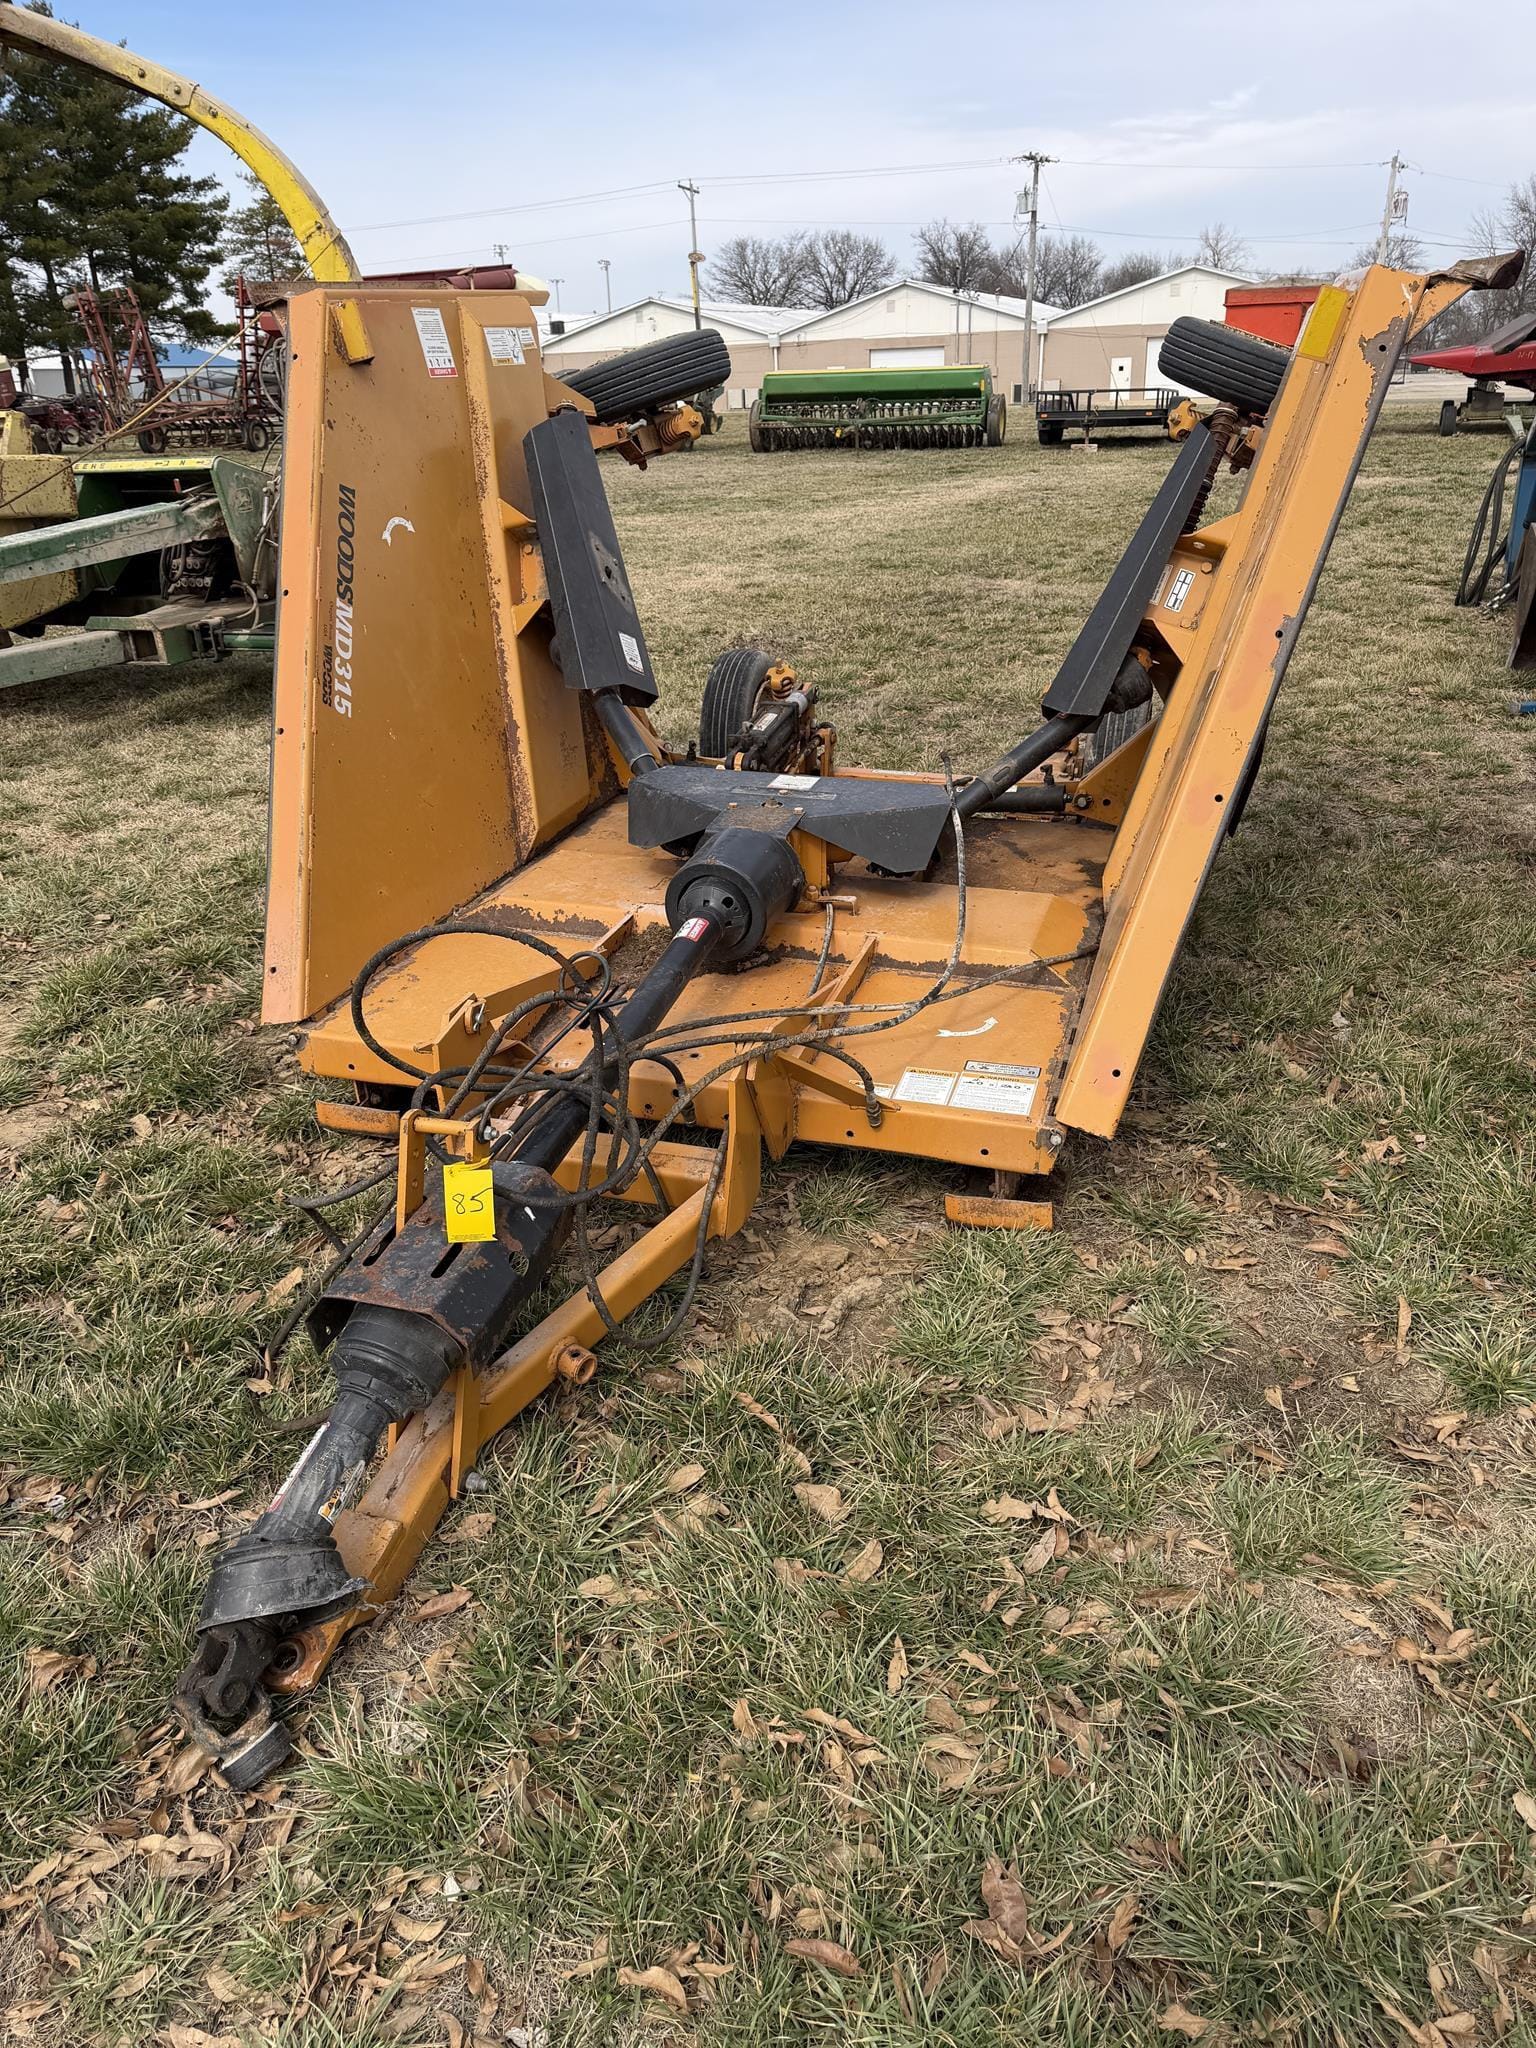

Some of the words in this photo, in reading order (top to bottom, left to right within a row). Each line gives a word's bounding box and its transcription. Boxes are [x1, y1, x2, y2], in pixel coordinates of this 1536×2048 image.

[337, 483, 356, 605] WOODS
[334, 598, 353, 719] MD315
[918, 1069, 953, 1077] WARNING
[452, 1187, 493, 1214] 85
